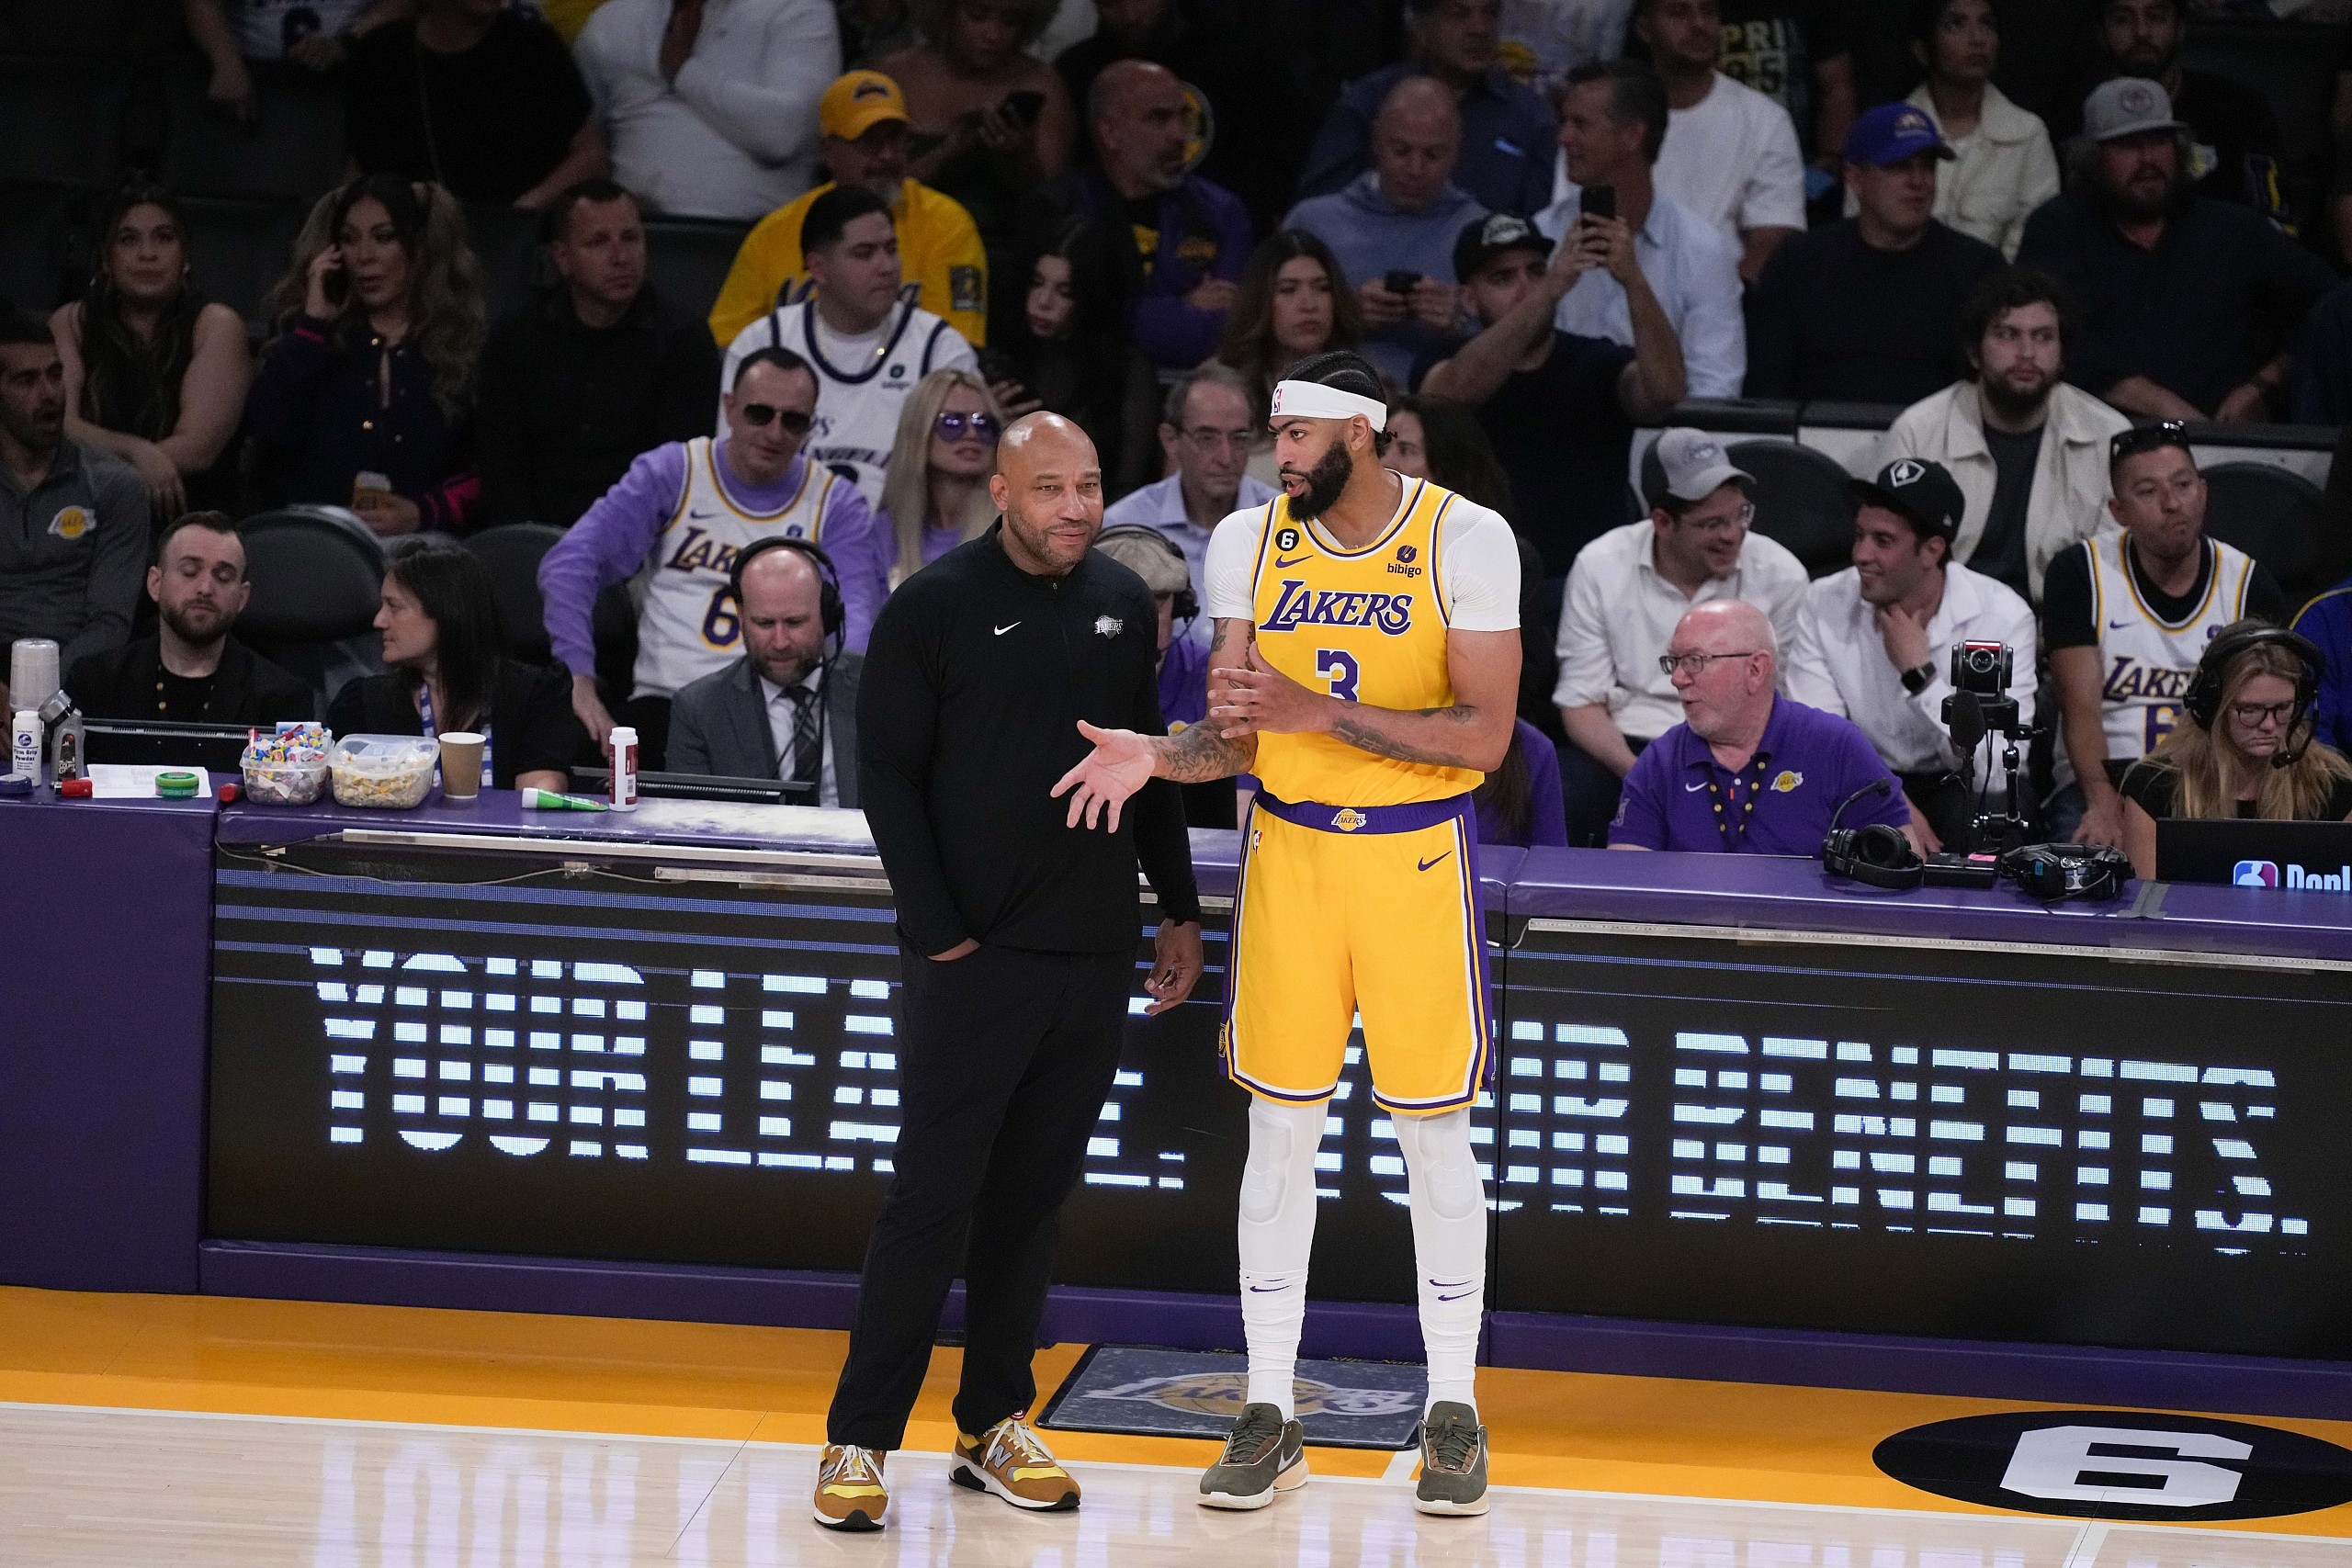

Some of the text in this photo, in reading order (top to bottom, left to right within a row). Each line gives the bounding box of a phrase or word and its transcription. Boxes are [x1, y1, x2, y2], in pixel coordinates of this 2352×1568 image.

[1281, 531, 1295, 549] 6
[1386, 562, 1422, 579] bibigo
[701, 584, 742, 651] 6
[1257, 579, 1415, 637] LAKERS
[1315, 647, 1361, 703] 3
[310, 947, 648, 1160] YOUR
[1999, 1425, 2254, 1506] 6
